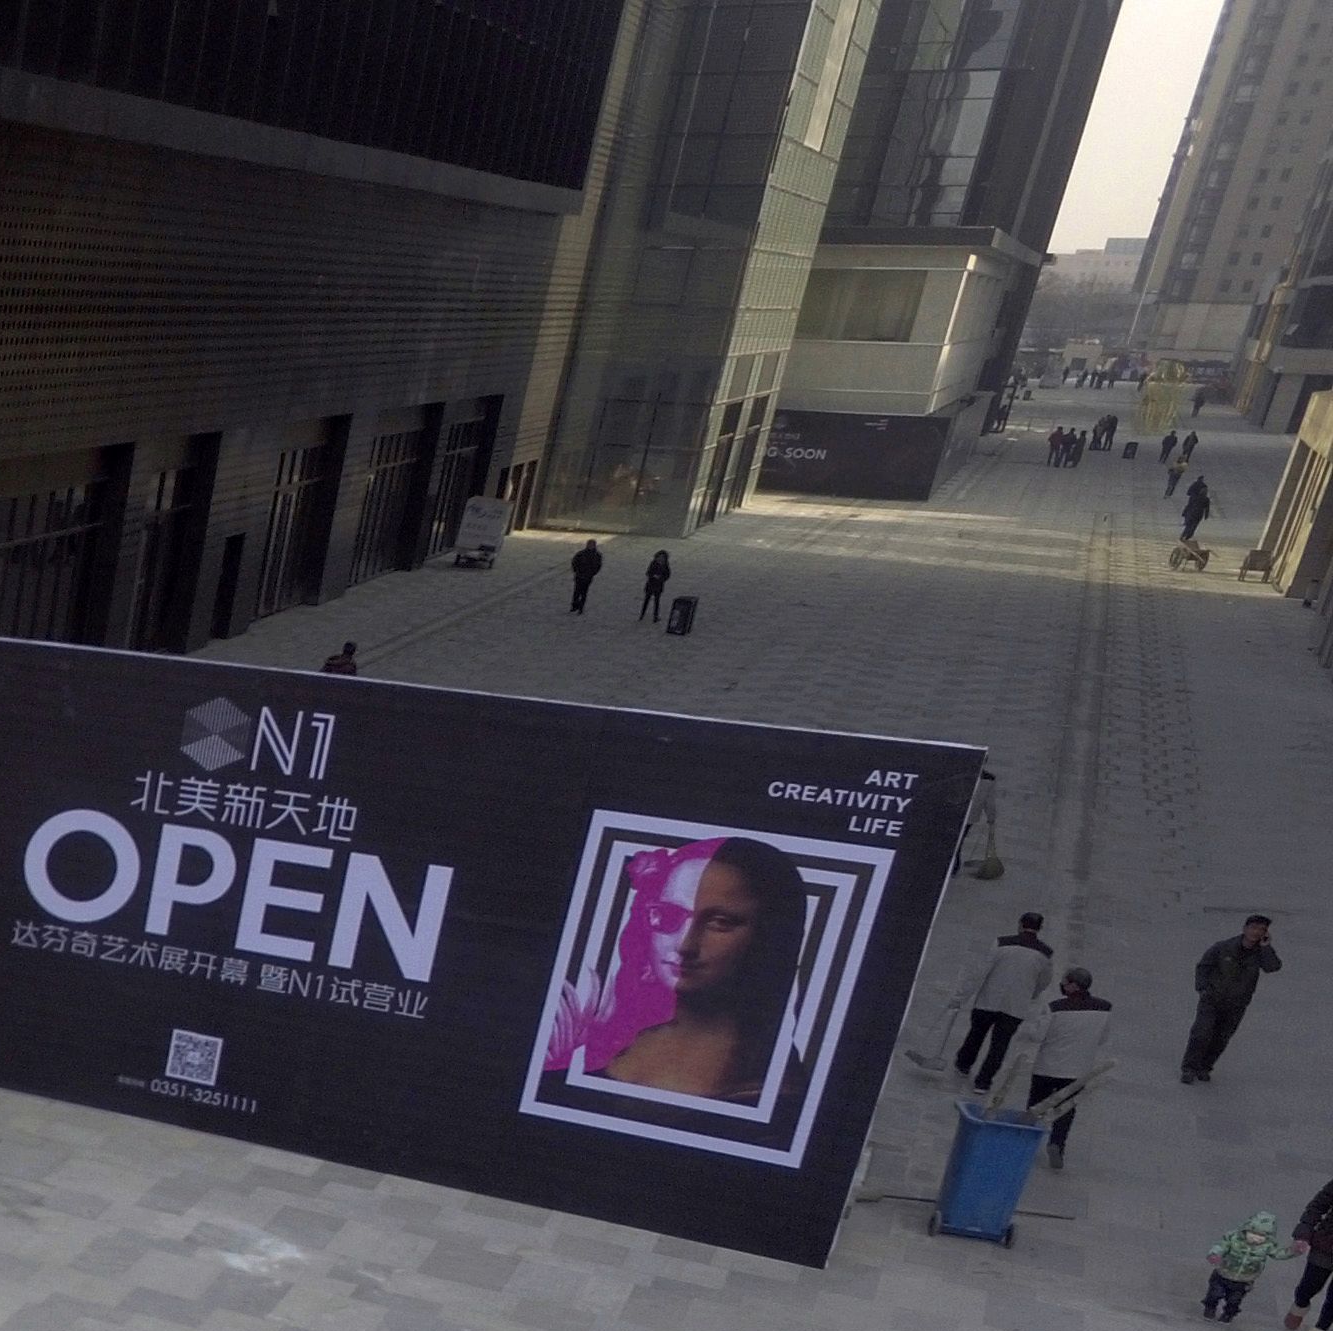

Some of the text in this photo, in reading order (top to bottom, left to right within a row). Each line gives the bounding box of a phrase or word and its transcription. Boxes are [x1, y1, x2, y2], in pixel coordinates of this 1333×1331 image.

[250, 704, 336, 780] N1
[130, 770, 357, 842] 北美新天地
[768, 781, 912, 814] CREATIVITY
[864, 769, 919, 790] ART
[848, 815, 904, 838] LIFE
[23, 808, 454, 983] OPEN
[9, 921, 430, 1019] 达芬奇艺术展开幕 暨N1试营业
[149, 1078, 258, 1114] 0351-3251111
